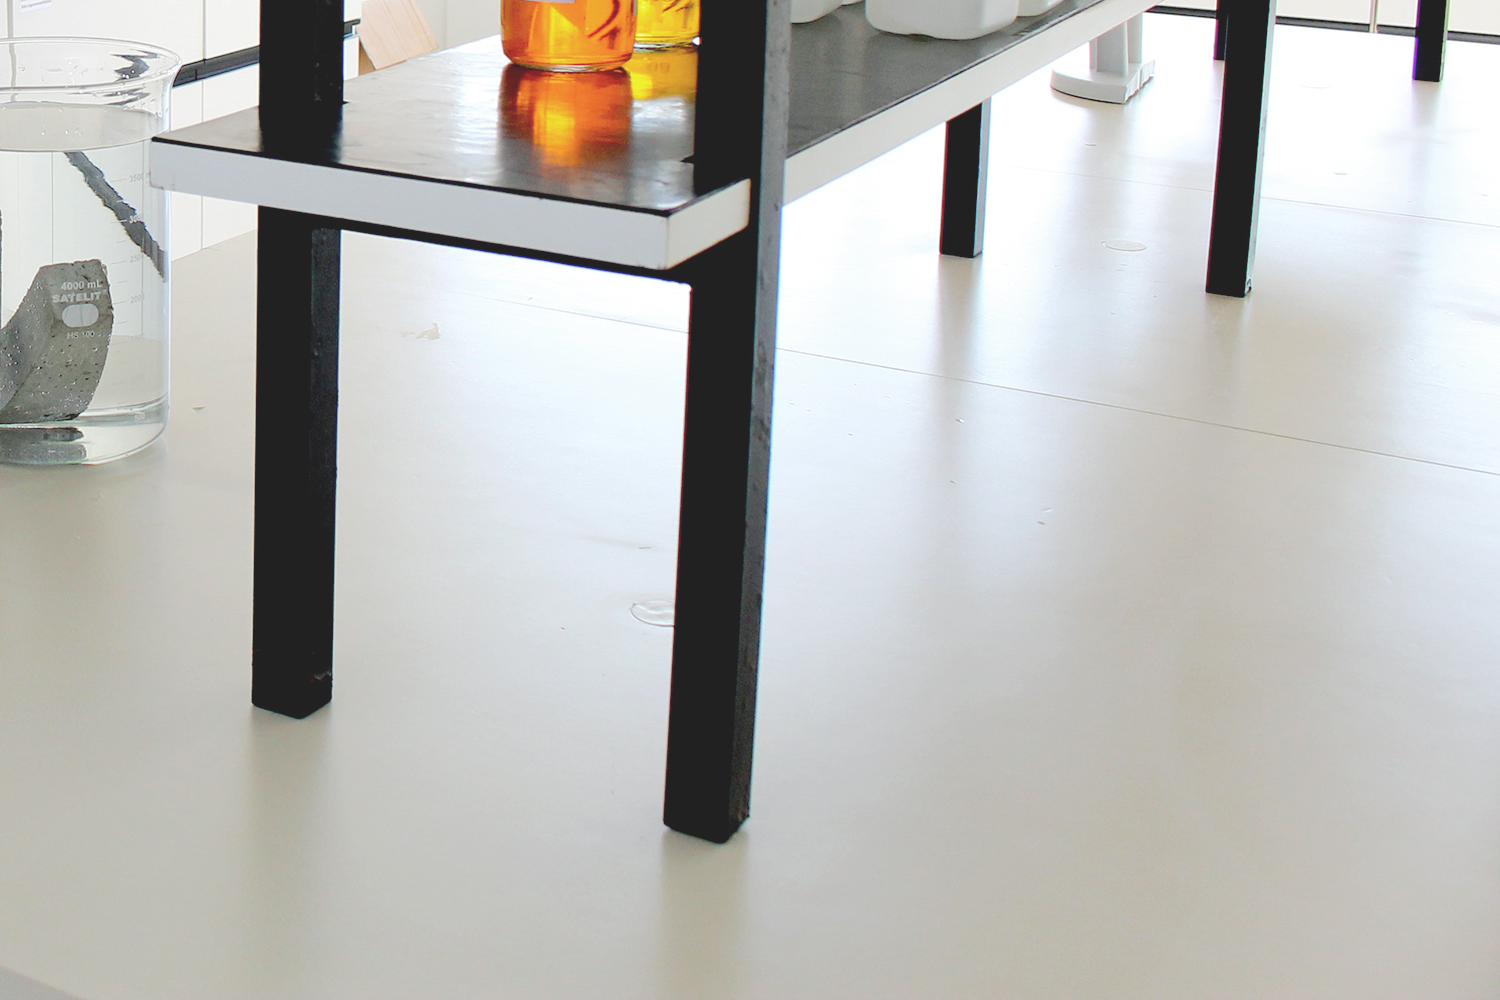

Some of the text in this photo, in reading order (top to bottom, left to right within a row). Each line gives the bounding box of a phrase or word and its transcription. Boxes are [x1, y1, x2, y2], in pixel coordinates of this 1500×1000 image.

[61, 279, 103, 291] 4000 mL
[52, 291, 101, 303] SATELIT
